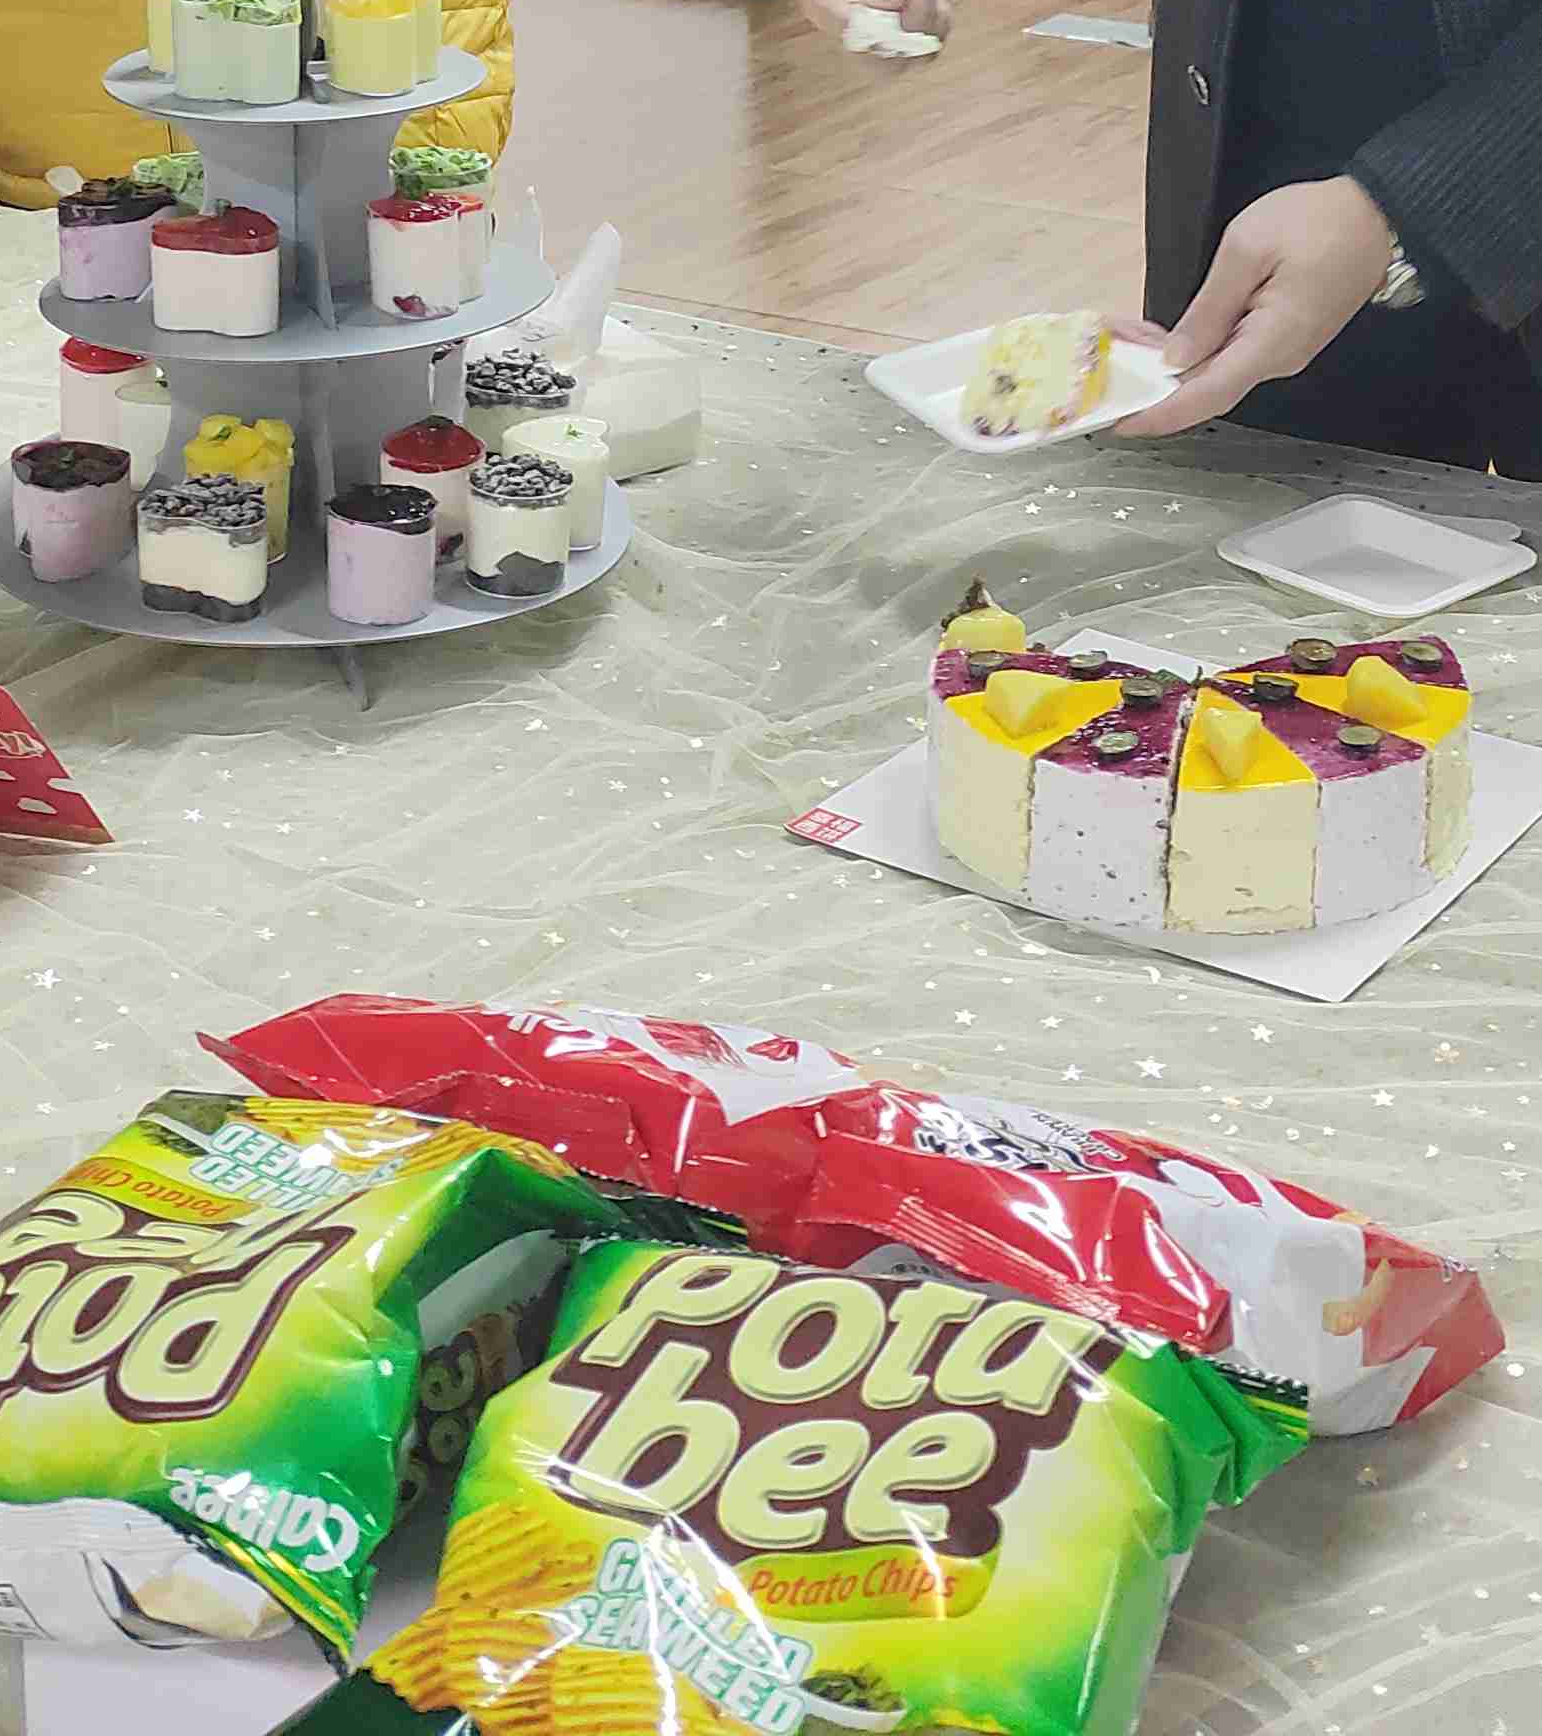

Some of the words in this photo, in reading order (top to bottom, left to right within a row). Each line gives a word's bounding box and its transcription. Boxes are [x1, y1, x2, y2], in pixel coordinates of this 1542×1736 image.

[130, 1181, 235, 1219] Potato
[577, 1255, 1107, 1417] Pota
[567, 1342, 997, 1550] bee
[170, 1467, 360, 1572] Calbee
[750, 1567, 855, 1608] Potato
[862, 1556, 956, 1603] Chips
